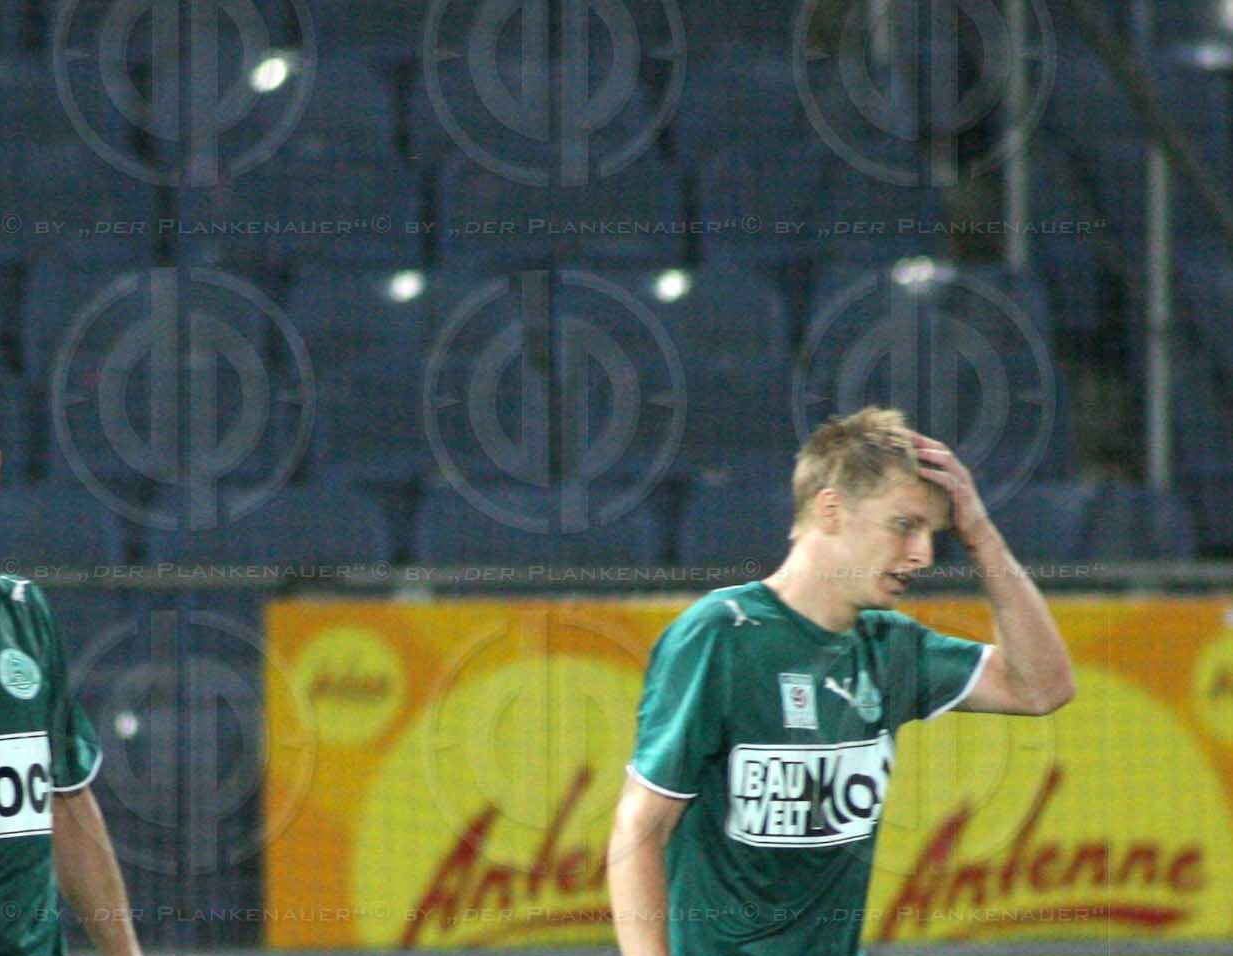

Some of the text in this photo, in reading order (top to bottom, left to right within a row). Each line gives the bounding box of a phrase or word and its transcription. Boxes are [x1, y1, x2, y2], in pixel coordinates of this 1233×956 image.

[742, 757, 806, 799] BAU
[734, 798, 810, 836] WELT
[879, 764, 1206, 944] Antenne
